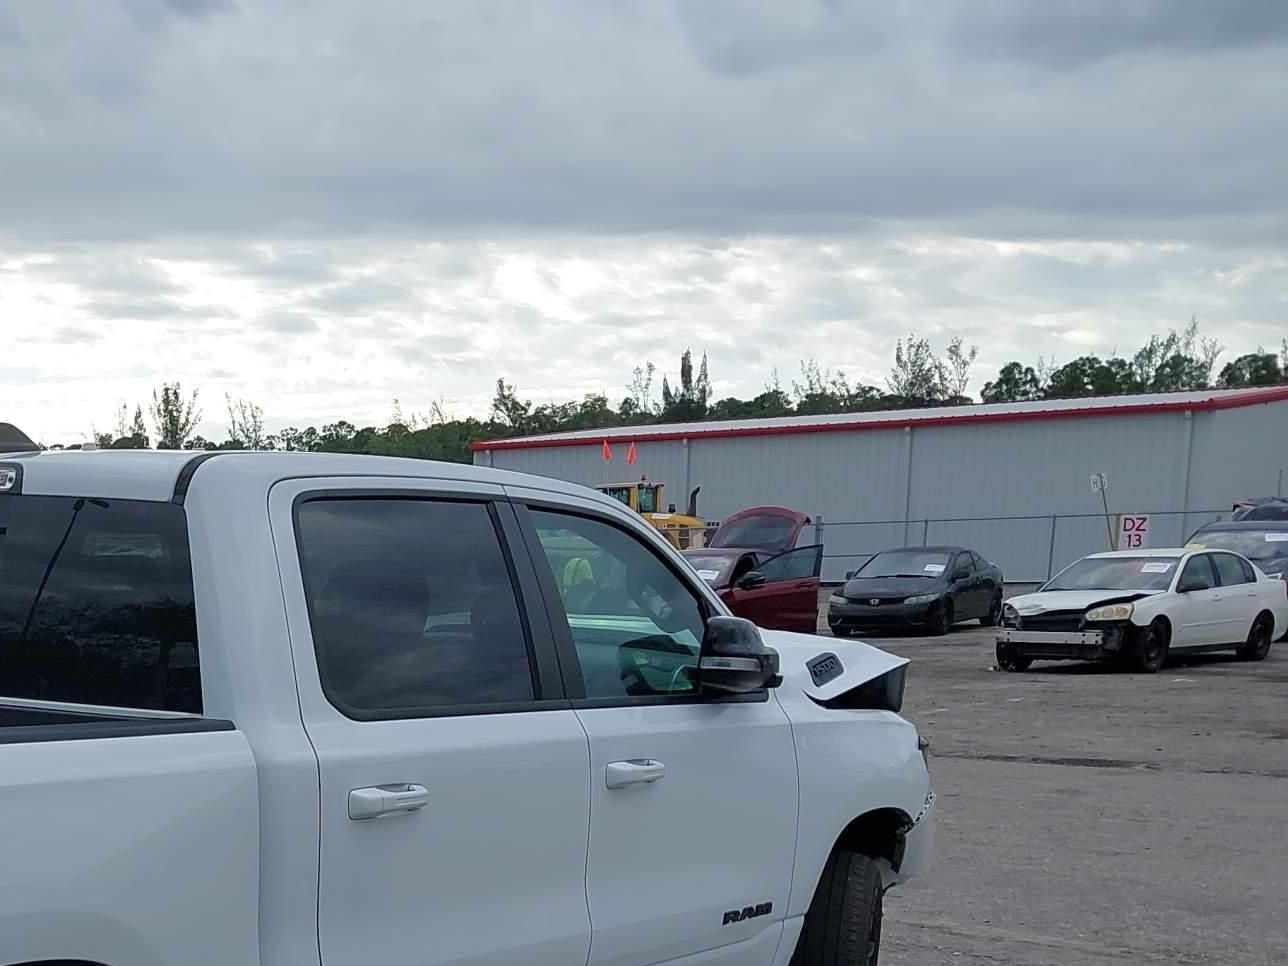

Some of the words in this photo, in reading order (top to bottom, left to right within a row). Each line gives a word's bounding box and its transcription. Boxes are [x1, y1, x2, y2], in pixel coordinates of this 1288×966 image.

[1123, 517, 1147, 532] DZ
[1126, 533, 1142, 548] 13
[721, 901, 773, 926] RAM
